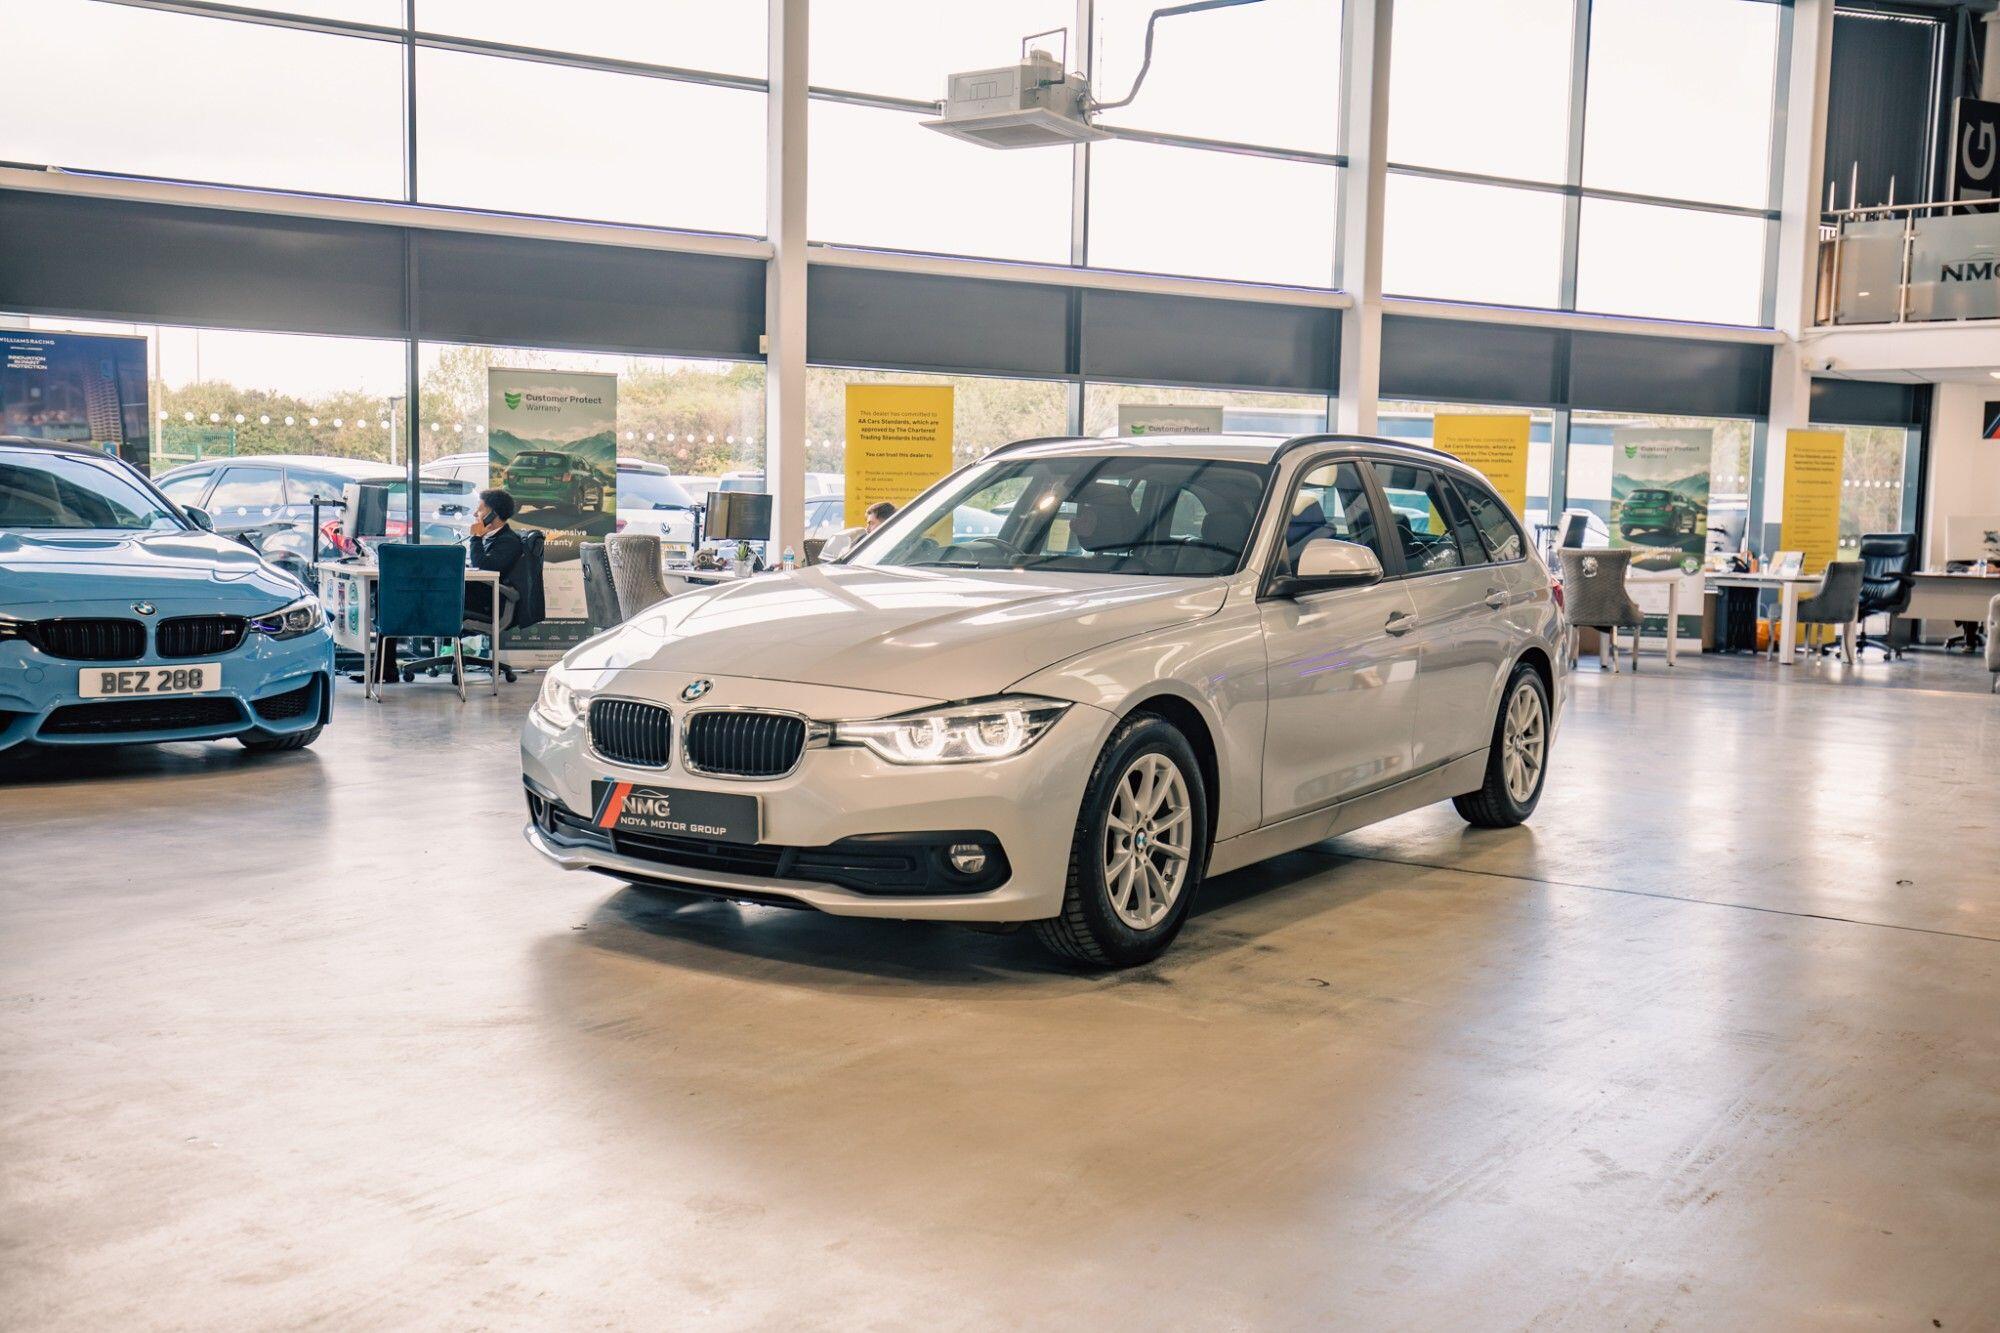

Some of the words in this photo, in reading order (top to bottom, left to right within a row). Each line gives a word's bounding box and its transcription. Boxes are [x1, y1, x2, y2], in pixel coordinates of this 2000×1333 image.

[525, 393, 567, 403] Customer
[569, 395, 602, 404] Protect
[525, 403, 561, 412] Warranty
[1148, 425, 1182, 433] Customer
[1183, 425, 1210, 433] Protect
[101, 671, 150, 694] BEZ
[157, 668, 204, 692] 288
[621, 797, 670, 817] NMG
[620, 816, 648, 827] NOYA
[650, 819, 687, 831] MOTOR
[690, 823, 728, 835] GROUP
